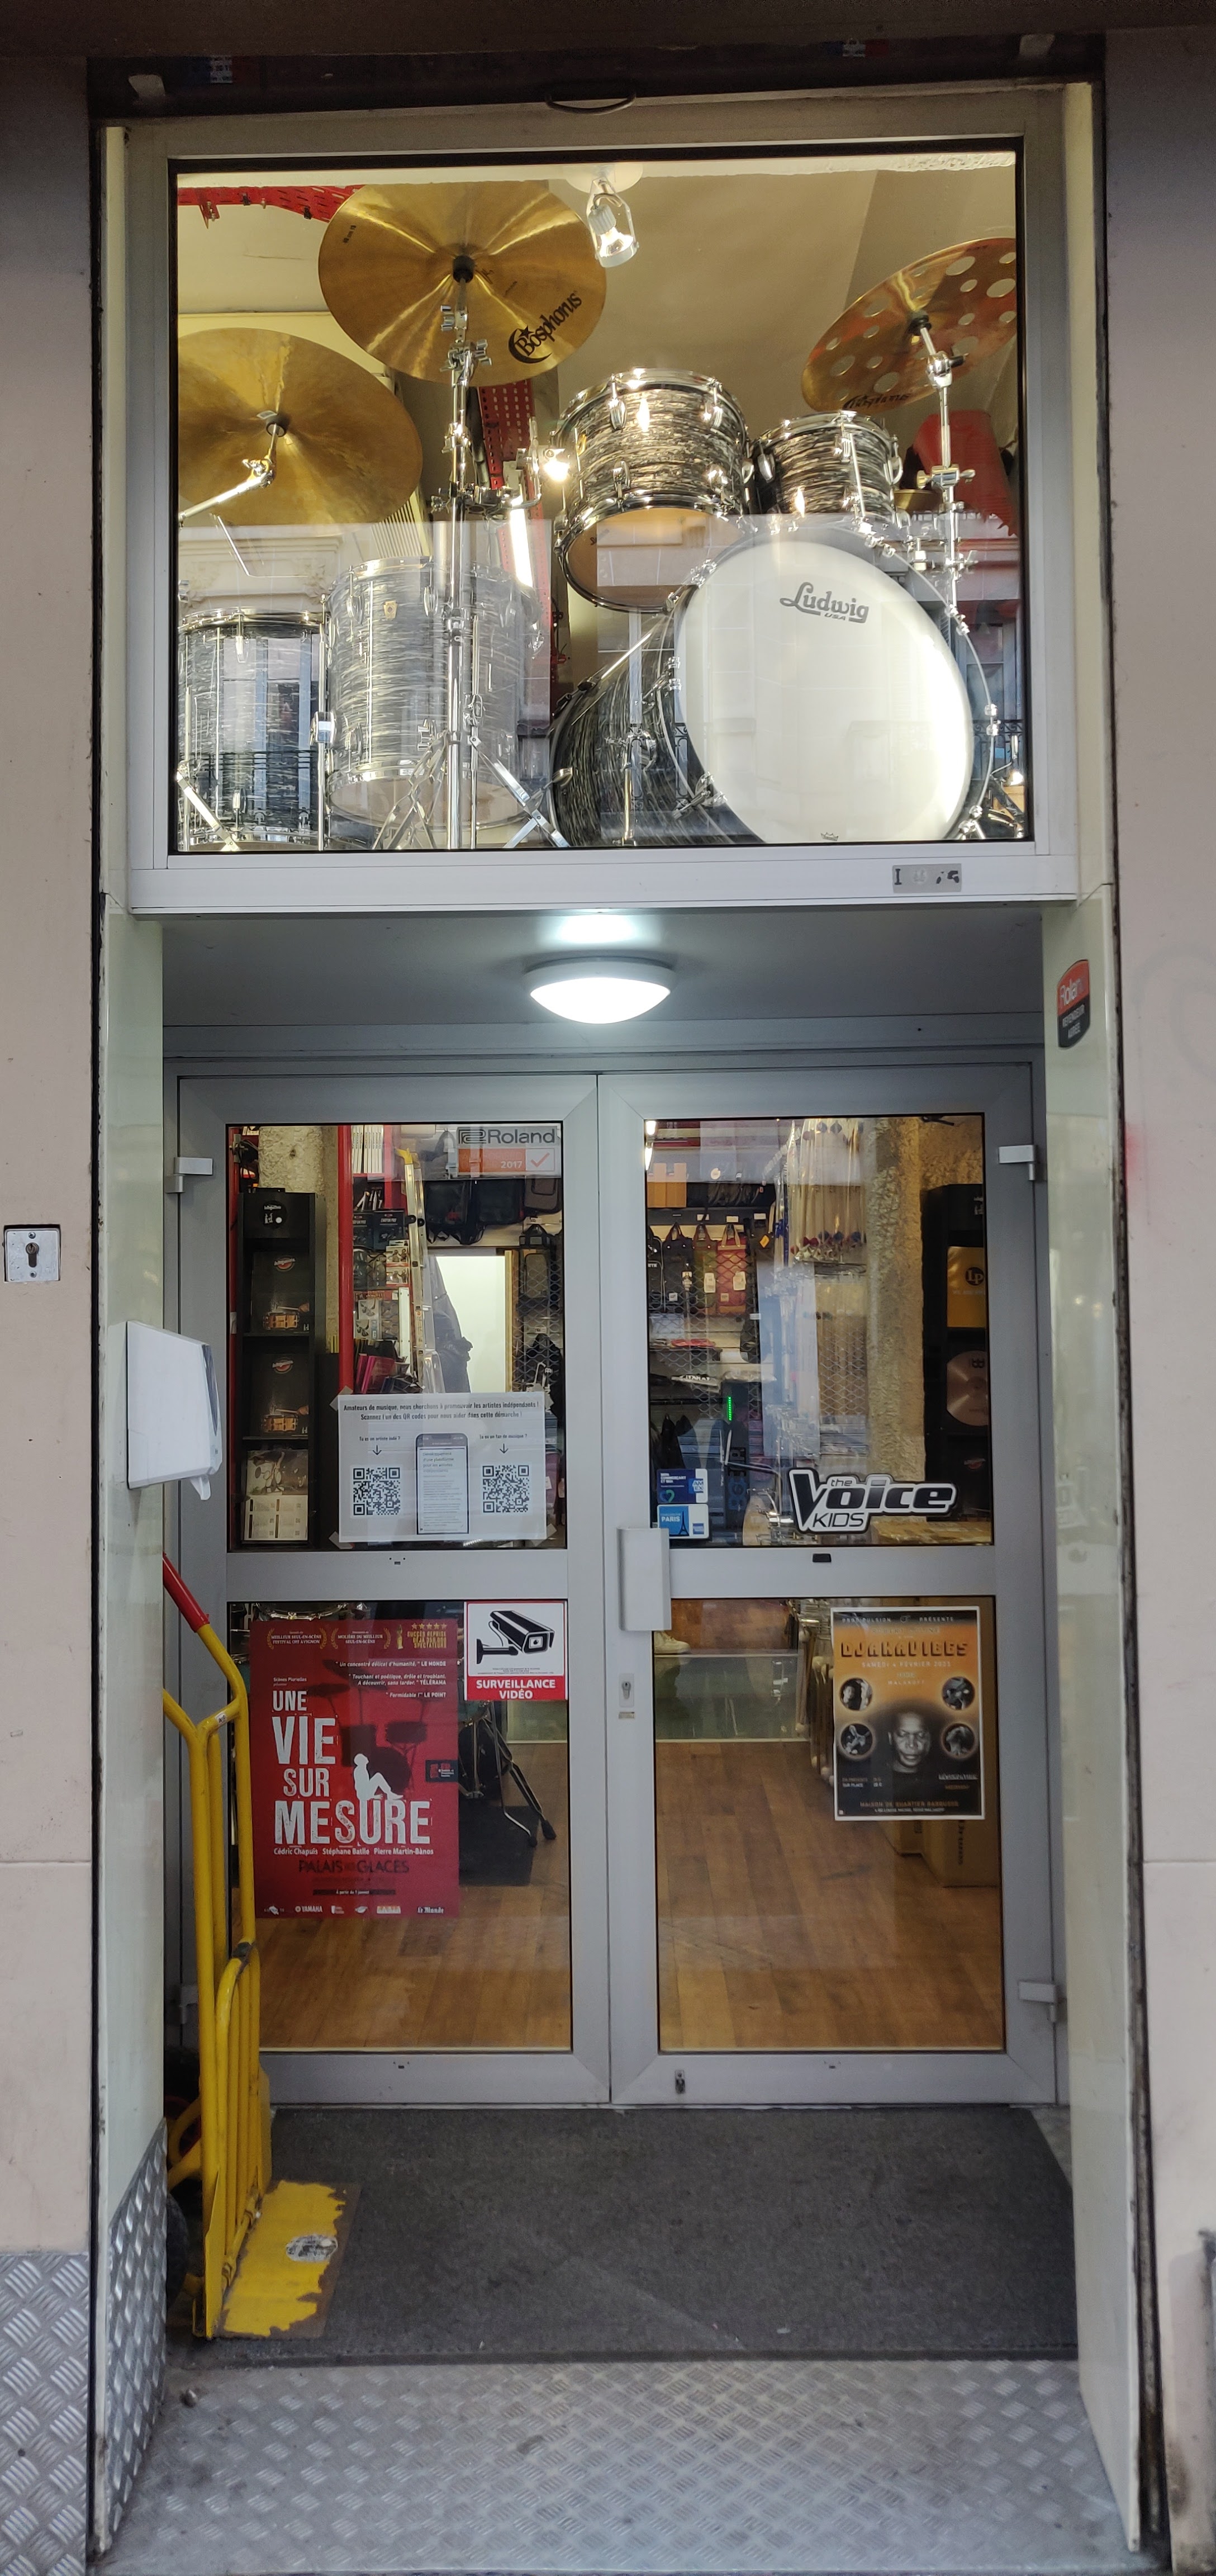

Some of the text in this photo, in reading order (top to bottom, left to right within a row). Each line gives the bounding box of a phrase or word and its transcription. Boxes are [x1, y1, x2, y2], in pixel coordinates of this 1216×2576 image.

[514, 292, 582, 357] Bosphorus
[780, 581, 870, 624] Ludwig
[1060, 978, 1086, 1008] Rolan
[488, 1128, 555, 1144] Roland
[501, 1161, 522, 1169] 2017
[792, 1474, 953, 1527] Voice
[813, 1513, 865, 1528] KIDS
[476, 1679, 556, 1689] SURVEILLANCE
[499, 1688, 533, 1699] VIDÉO
[273, 1690, 307, 1711] UNE
[272, 1716, 336, 1765] VIE
[283, 1768, 330, 1797] SUR
[274, 1800, 430, 1845] MESURE
[294, 1847, 319, 1857] Chapuis
[322, 1847, 352, 1857] Stéphane
[298, 1859, 343, 1873] PALAIS
[356, 1859, 410, 1874] GLACES
